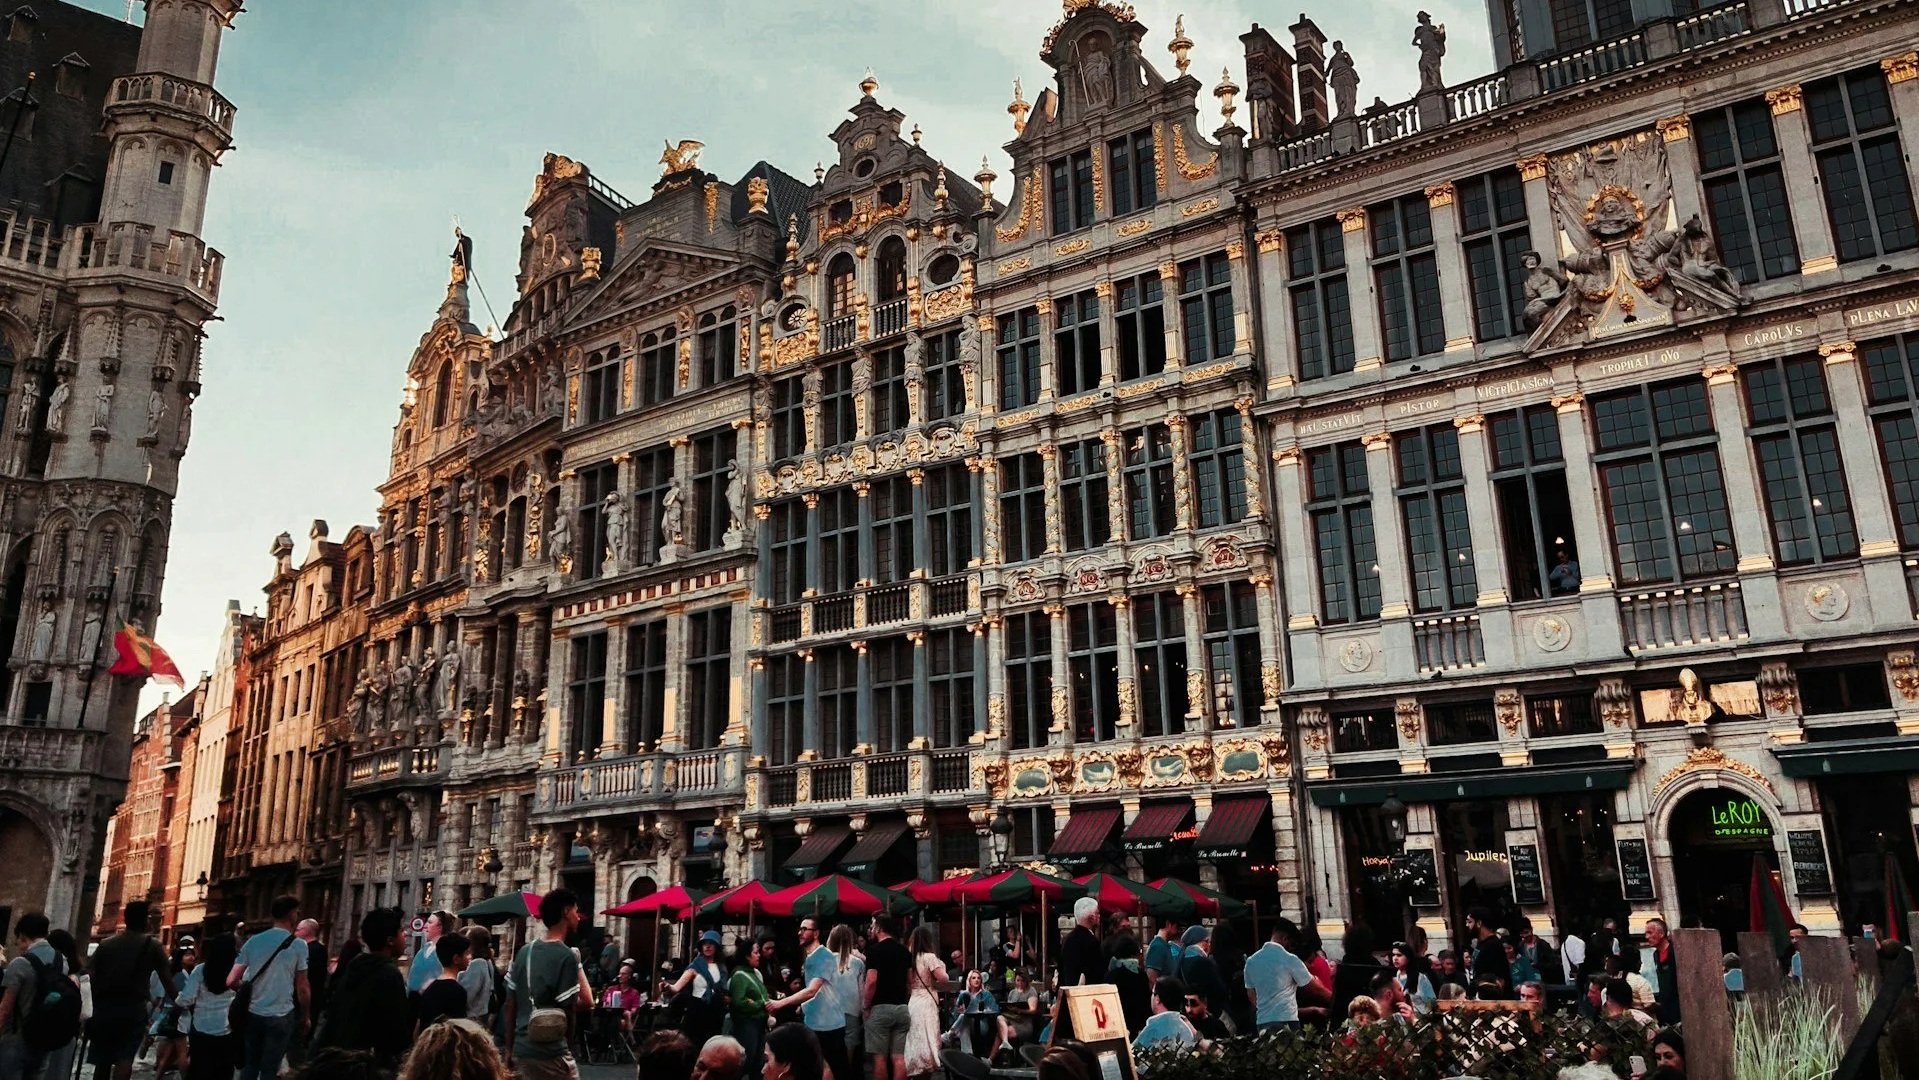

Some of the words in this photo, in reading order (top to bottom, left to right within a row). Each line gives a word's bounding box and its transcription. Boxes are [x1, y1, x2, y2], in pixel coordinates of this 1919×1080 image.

[1850, 309, 1890, 325] PLENA
[1744, 323, 1803, 347] CAROLVS
[1529, 376, 1555, 389] SIGNA
[1400, 399, 1440, 415] PISTOR
[1464, 850, 1506, 863] Jupiler
